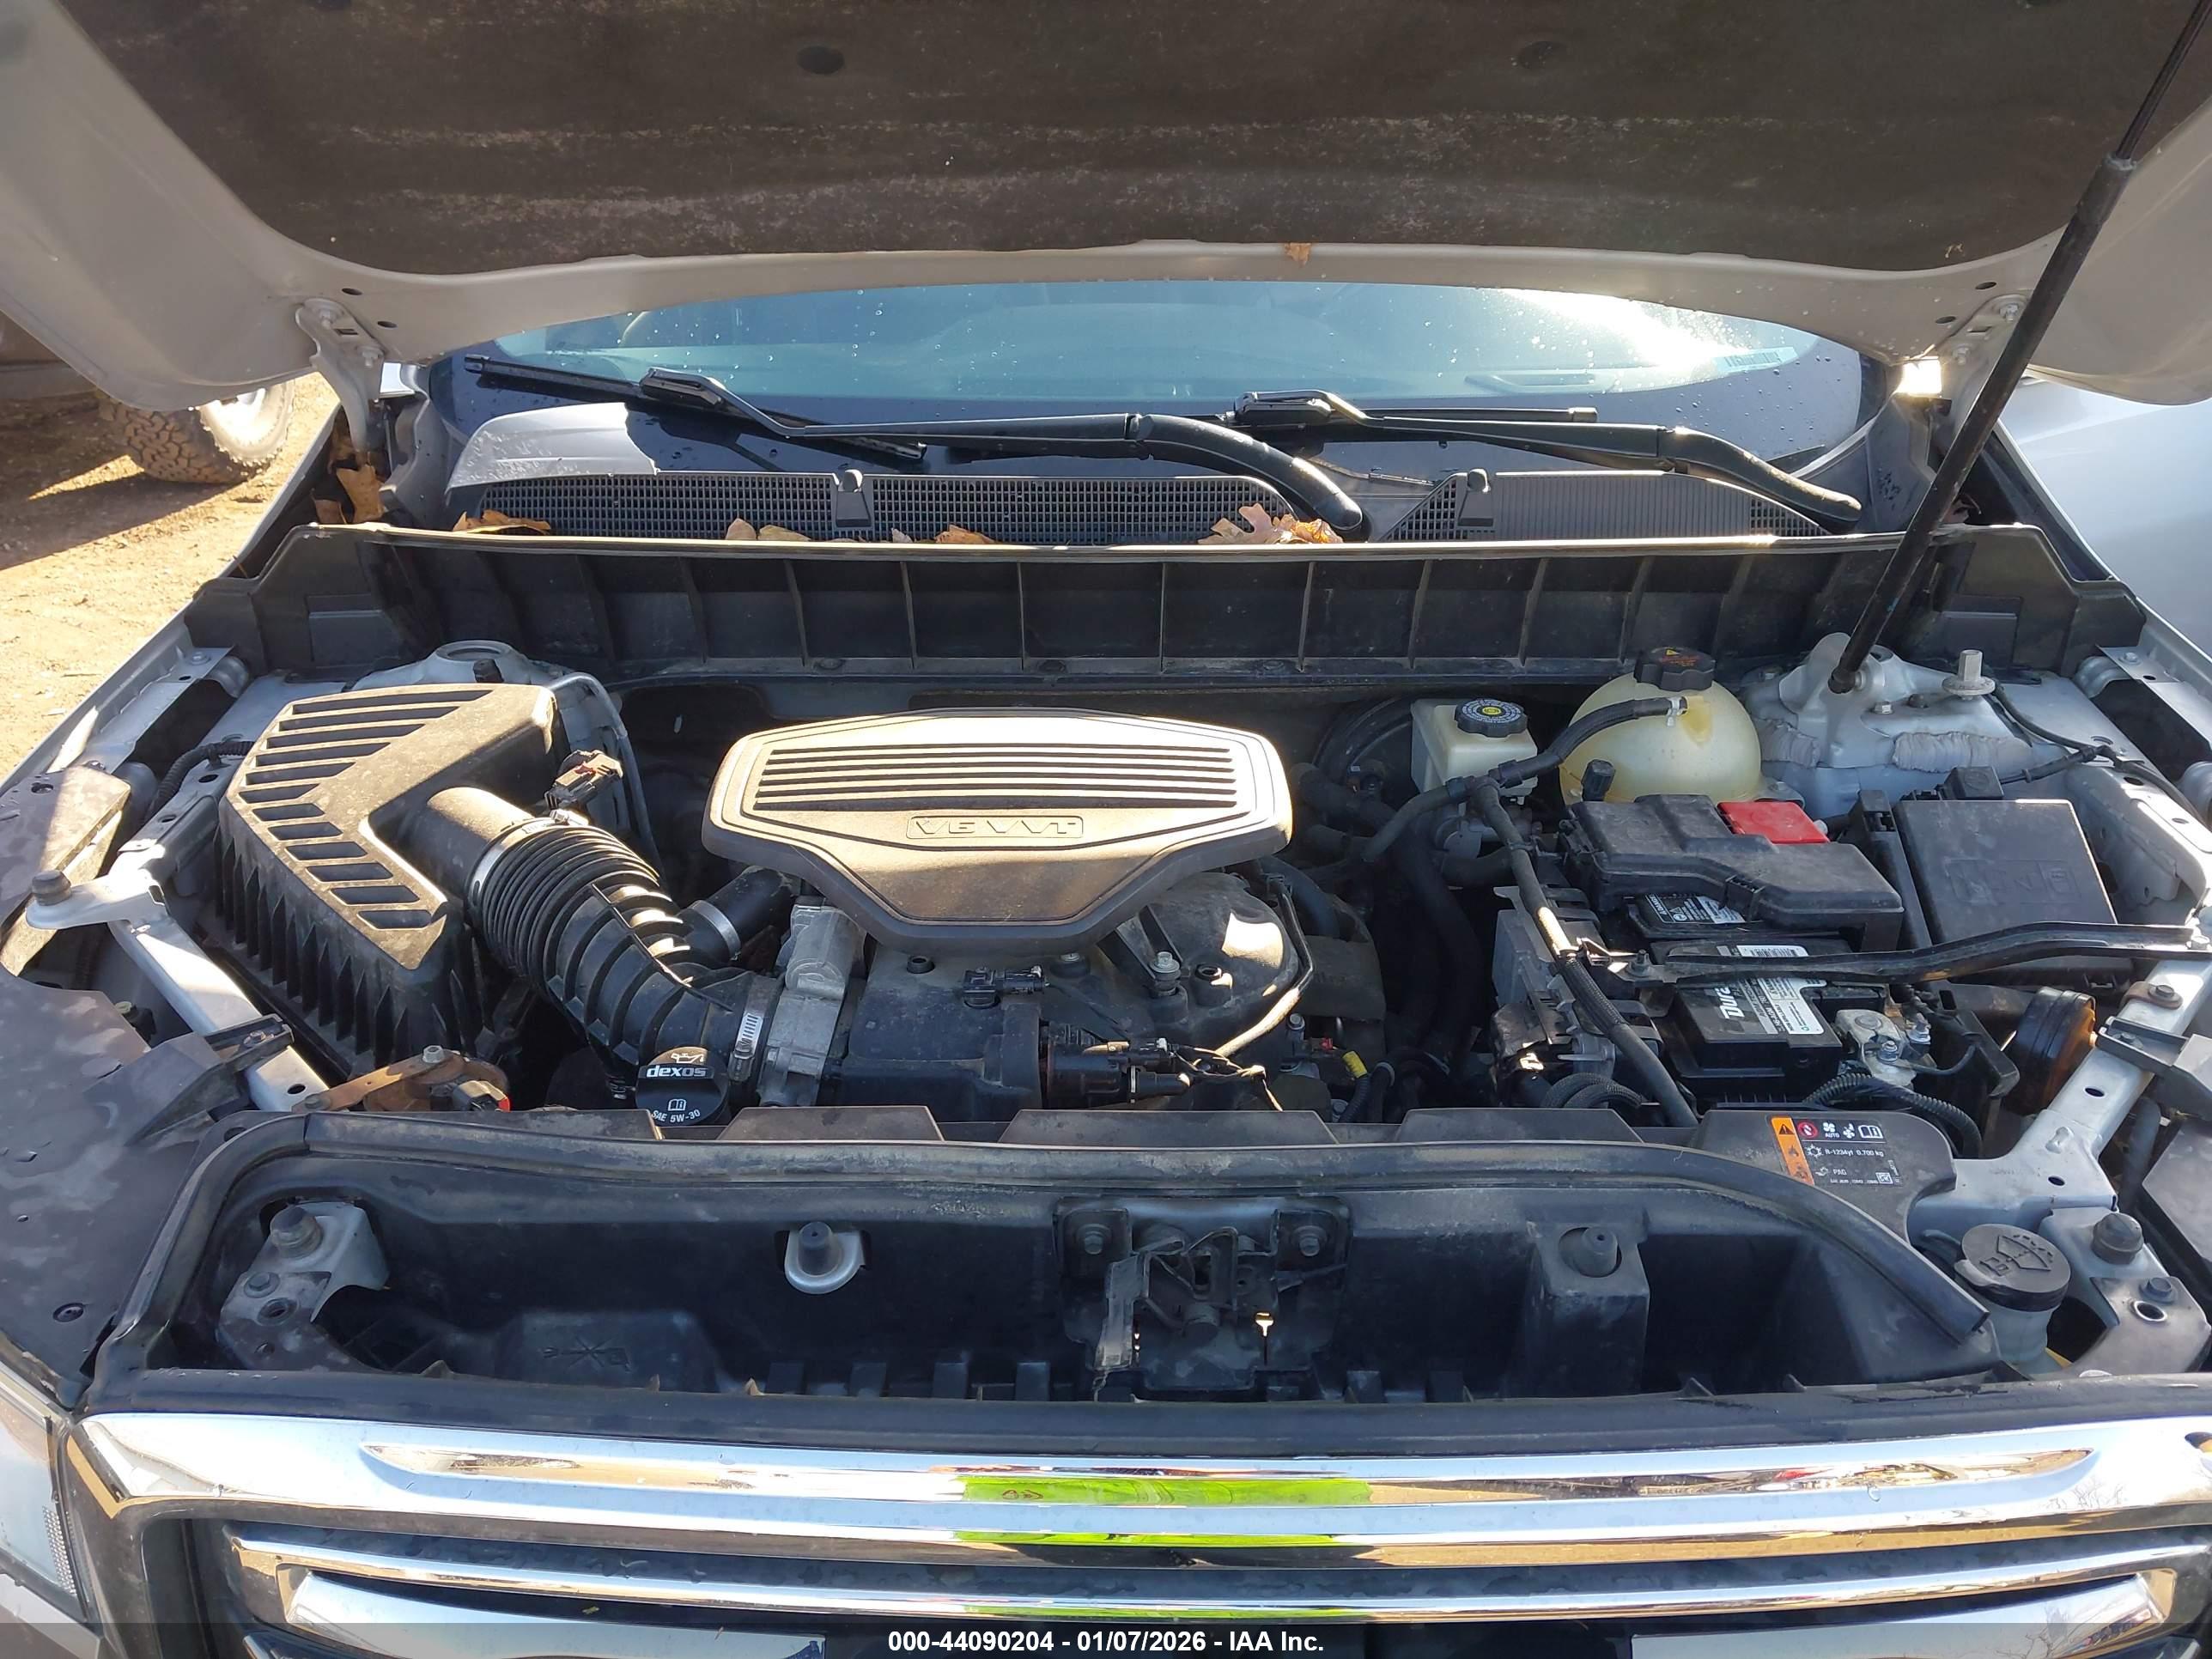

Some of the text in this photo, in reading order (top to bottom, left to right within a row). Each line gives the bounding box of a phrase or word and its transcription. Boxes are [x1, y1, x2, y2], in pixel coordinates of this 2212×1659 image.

[915, 819, 1077, 834] V6 VVT
[646, 1065, 708, 1078] dexos
[652, 1109, 701, 1123] SAE 5W-30
